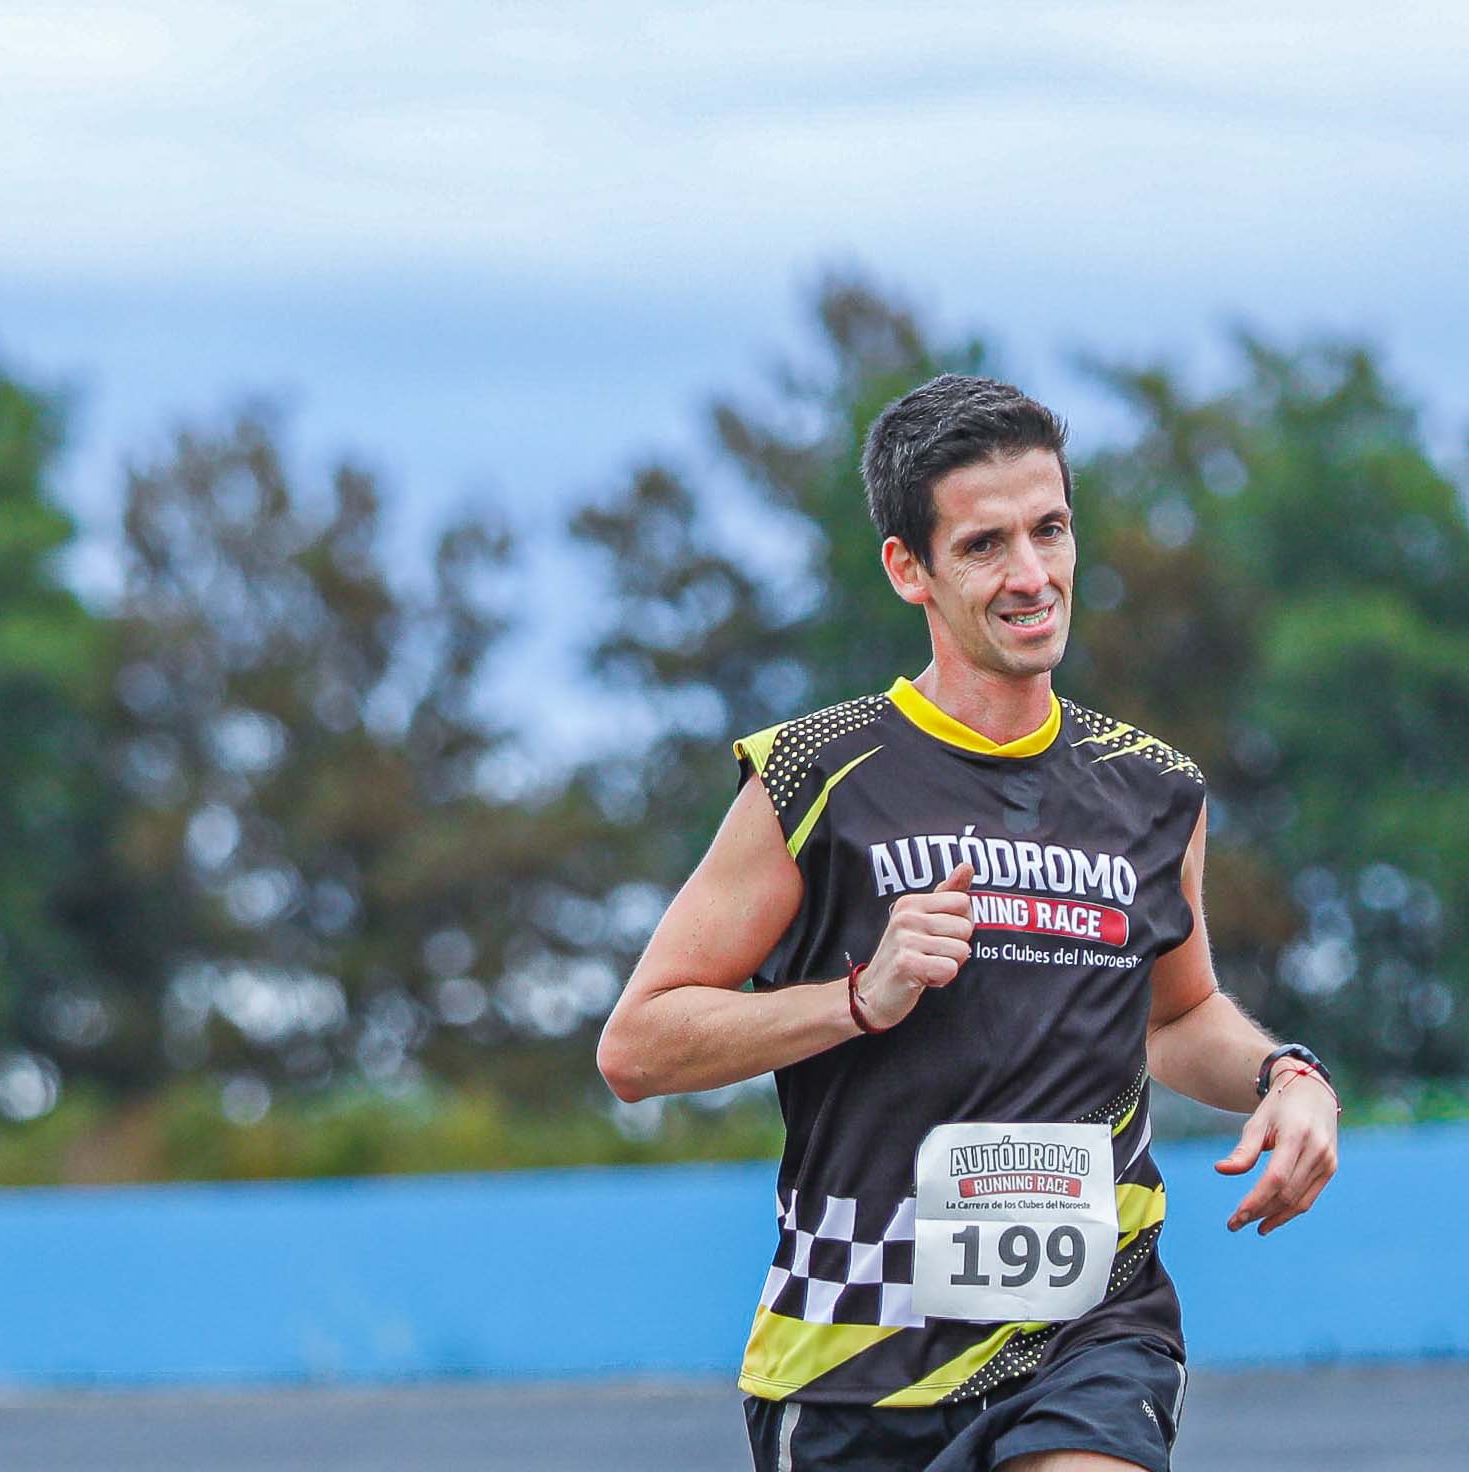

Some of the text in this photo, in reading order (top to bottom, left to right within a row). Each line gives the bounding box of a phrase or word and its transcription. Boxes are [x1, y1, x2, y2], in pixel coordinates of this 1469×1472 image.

[868, 824, 1138, 906] AUTÓDROMO
[971, 895, 1102, 939] NING RACE
[976, 941, 999, 960] los
[1002, 943, 1051, 964] Clubes
[1054, 947, 1079, 966] del
[949, 1134, 1090, 1177] AUTÓDROMO
[946, 1200, 957, 1210] La
[958, 1200, 990, 1210] Carrera
[991, 1199, 1003, 1210] de
[1004, 1199, 1017, 1210] los
[1018, 1200, 1045, 1210] Clubes
[1045, 1200, 1059, 1210] del
[972, 1175, 1071, 1196] RUNNING RACE
[949, 1225, 1087, 1288] 199
